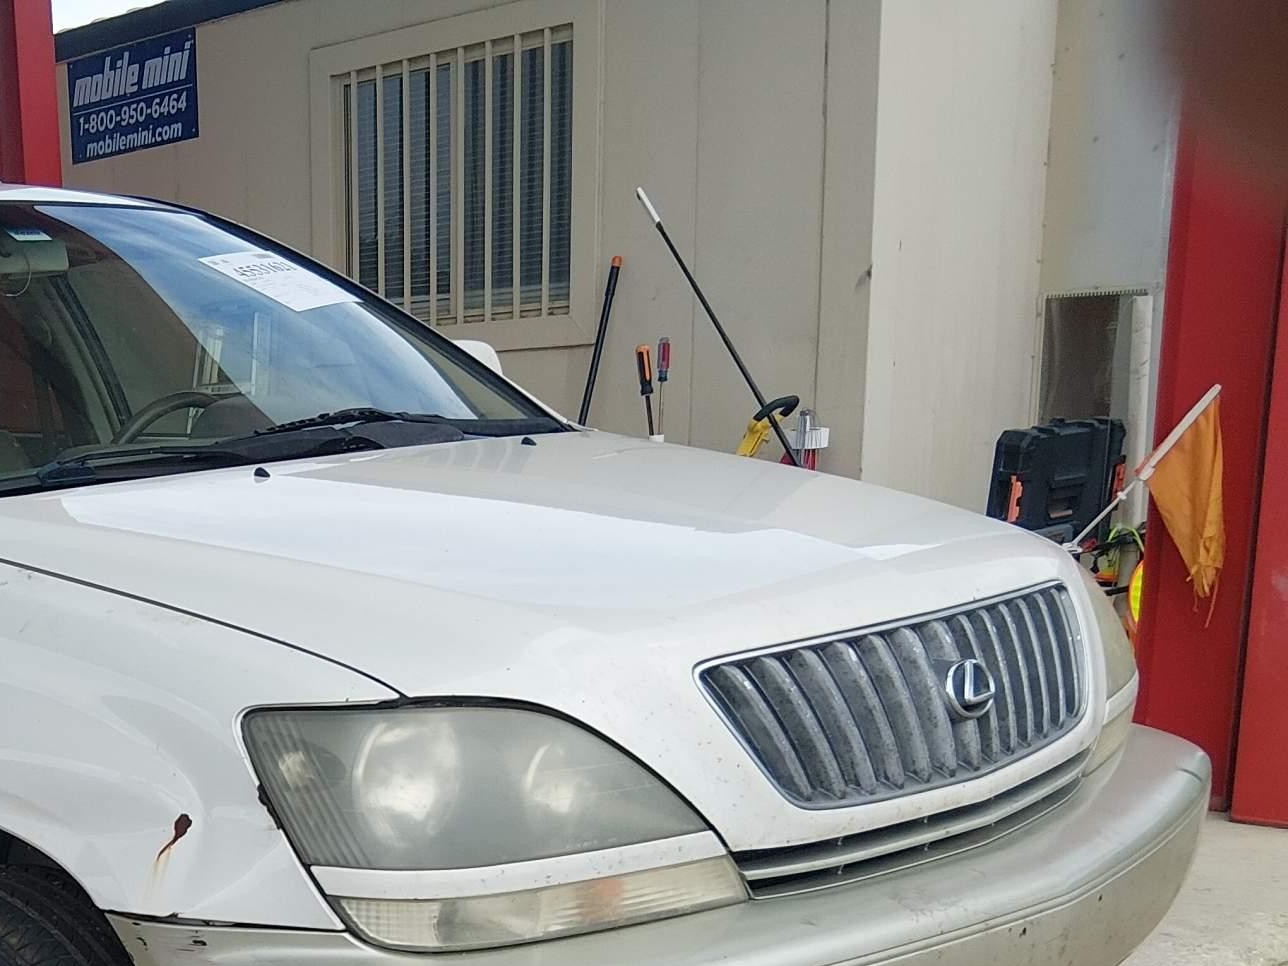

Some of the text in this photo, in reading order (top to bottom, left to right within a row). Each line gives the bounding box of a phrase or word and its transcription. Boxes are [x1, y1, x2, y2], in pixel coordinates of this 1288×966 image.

[73, 41, 192, 107] mobile mini
[79, 91, 187, 136] 1-800-950-6464
[86, 122, 182, 158] mobilemini.com
